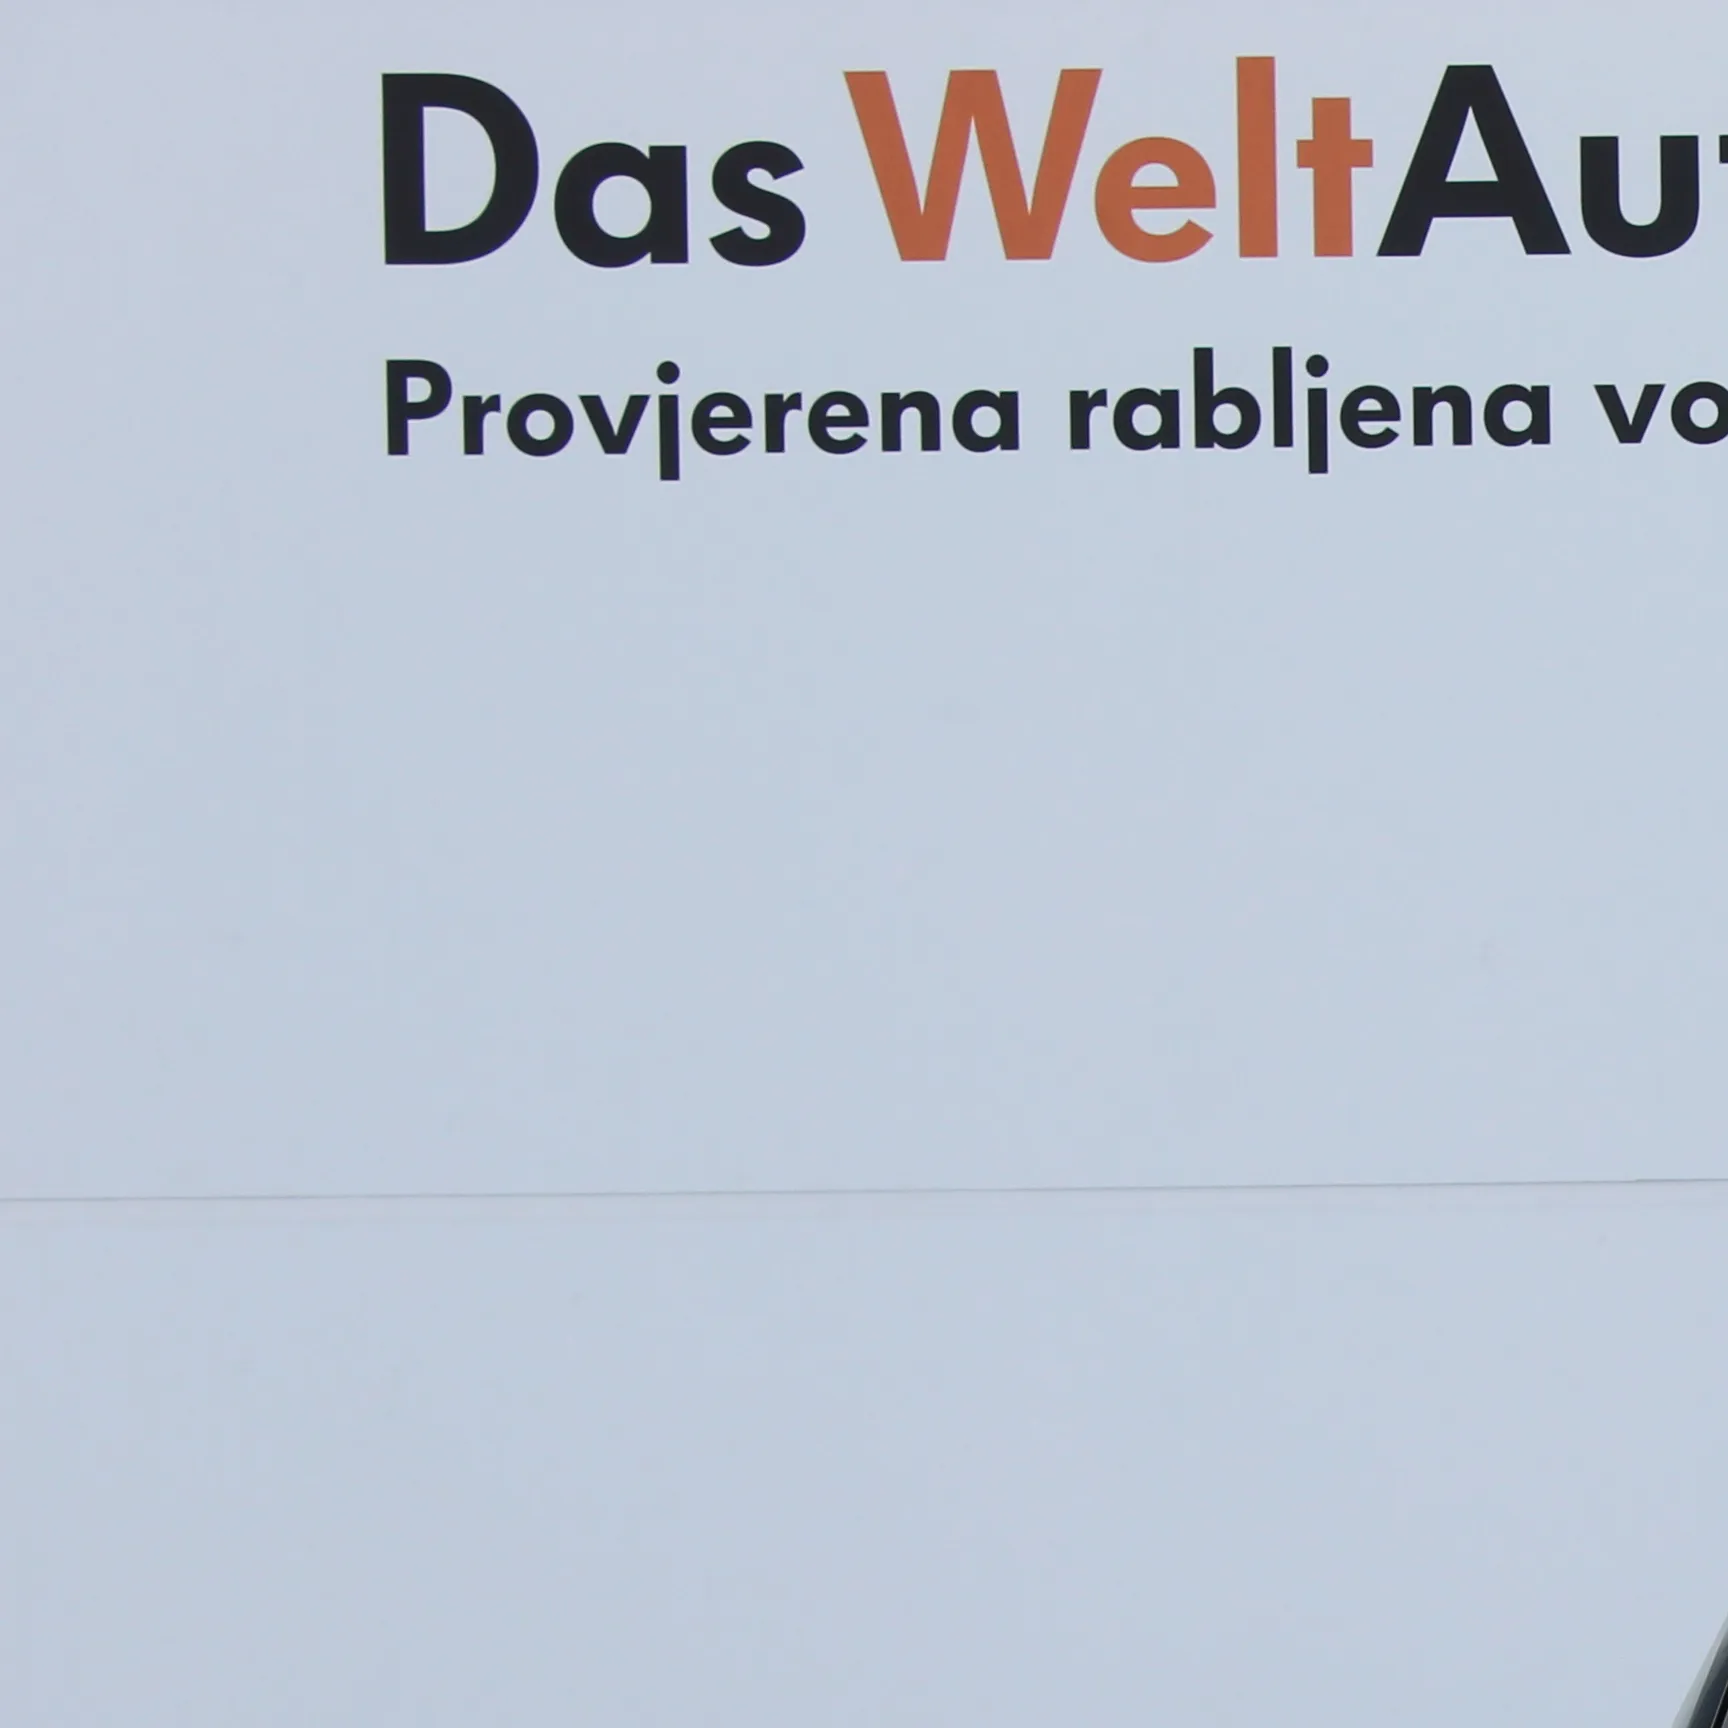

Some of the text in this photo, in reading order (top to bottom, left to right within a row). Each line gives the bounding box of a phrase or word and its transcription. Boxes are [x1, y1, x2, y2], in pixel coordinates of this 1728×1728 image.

[381, 72, 806, 269] Das
[385, 359, 1020, 482] Provjerena
[1069, 346, 1551, 475] rabljena
